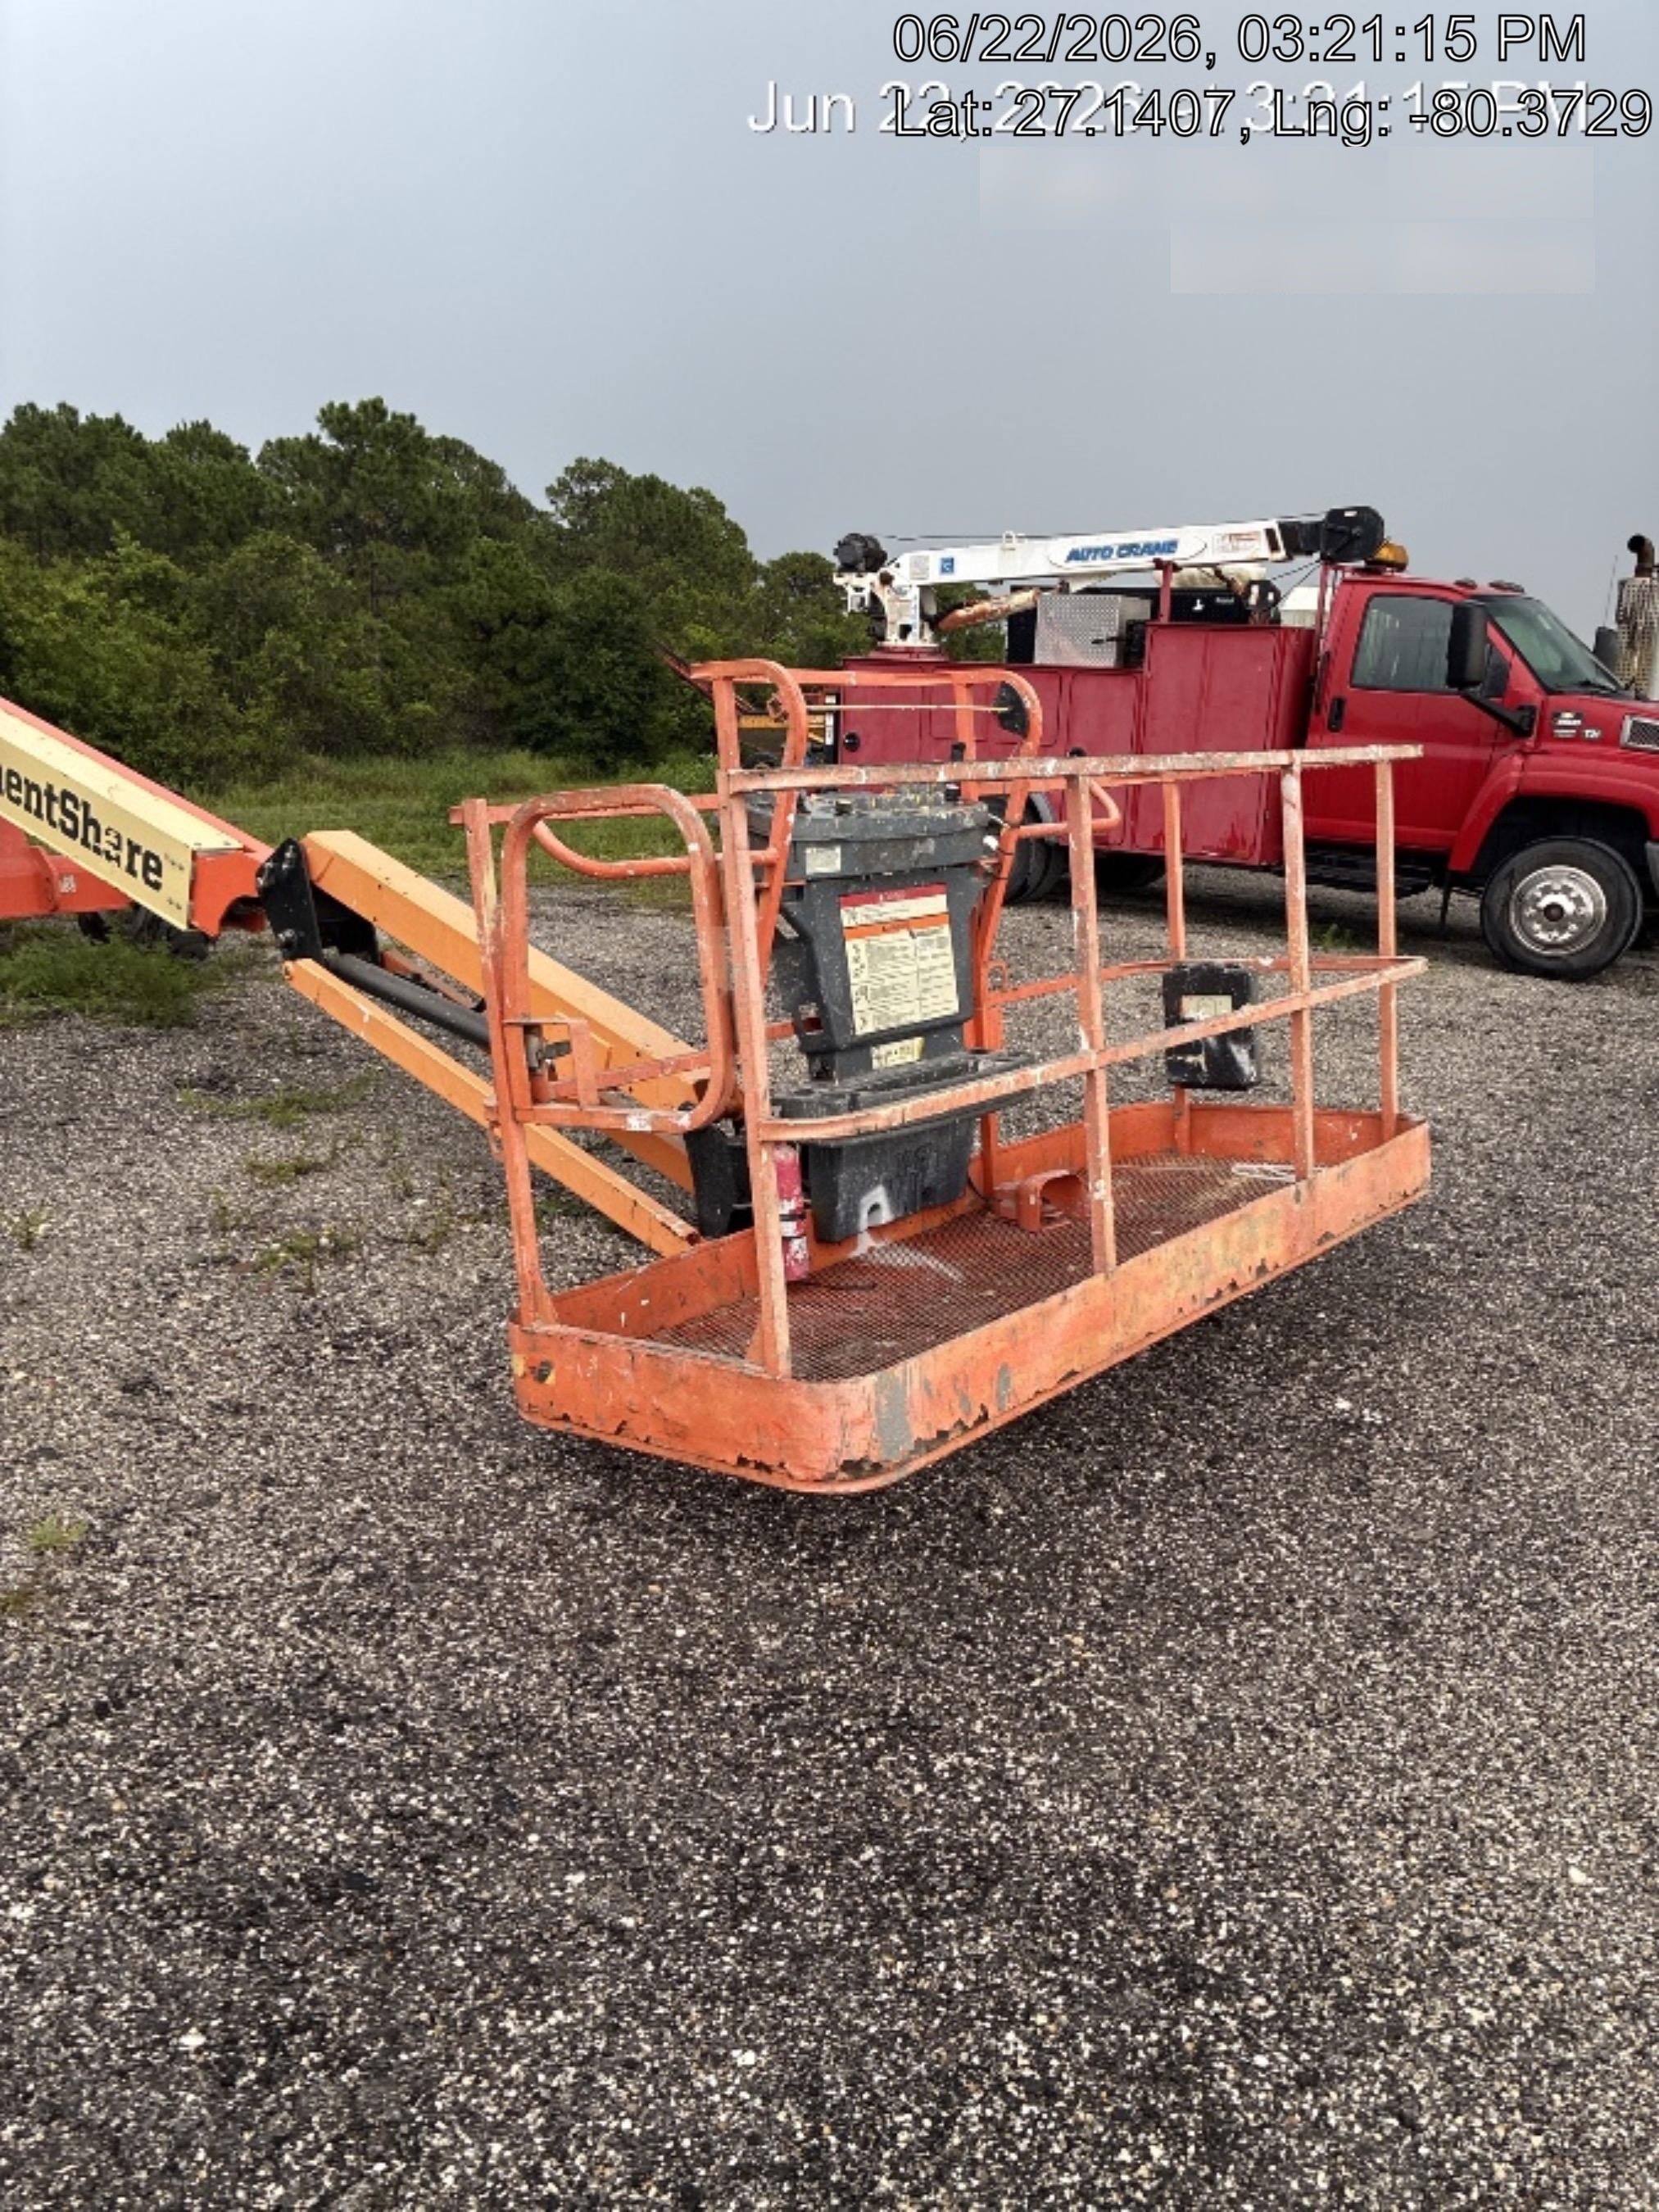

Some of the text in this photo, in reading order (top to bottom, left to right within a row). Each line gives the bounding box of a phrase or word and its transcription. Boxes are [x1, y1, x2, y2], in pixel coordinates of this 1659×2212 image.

[1066, 538, 1178, 562] AUTO CRANE
[0, 764, 163, 893] entShare
